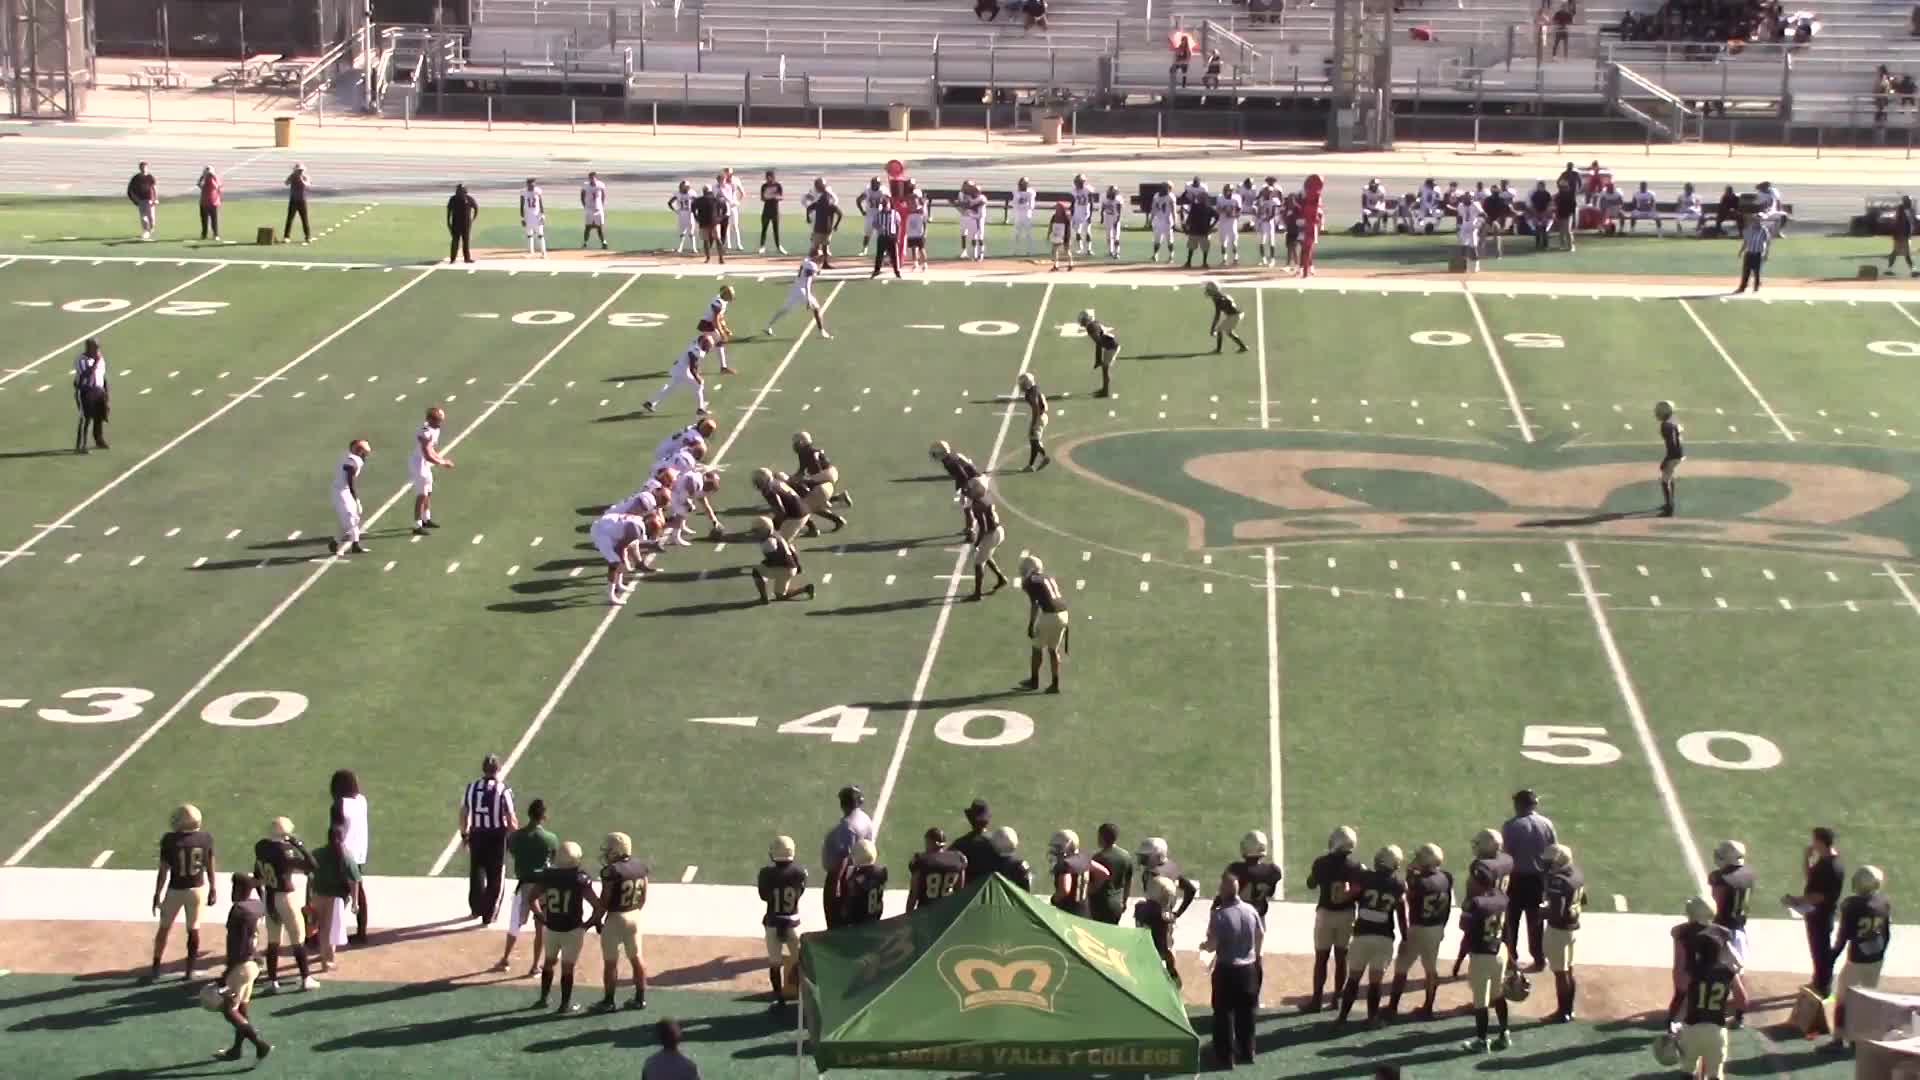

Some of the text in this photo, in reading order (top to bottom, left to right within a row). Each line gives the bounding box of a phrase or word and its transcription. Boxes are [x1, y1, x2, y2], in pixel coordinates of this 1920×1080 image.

[548, 887, 572, 913] 21
[1697, 980, 1726, 1010] 12
[1087, 1047, 1181, 1065] COLLEGE
